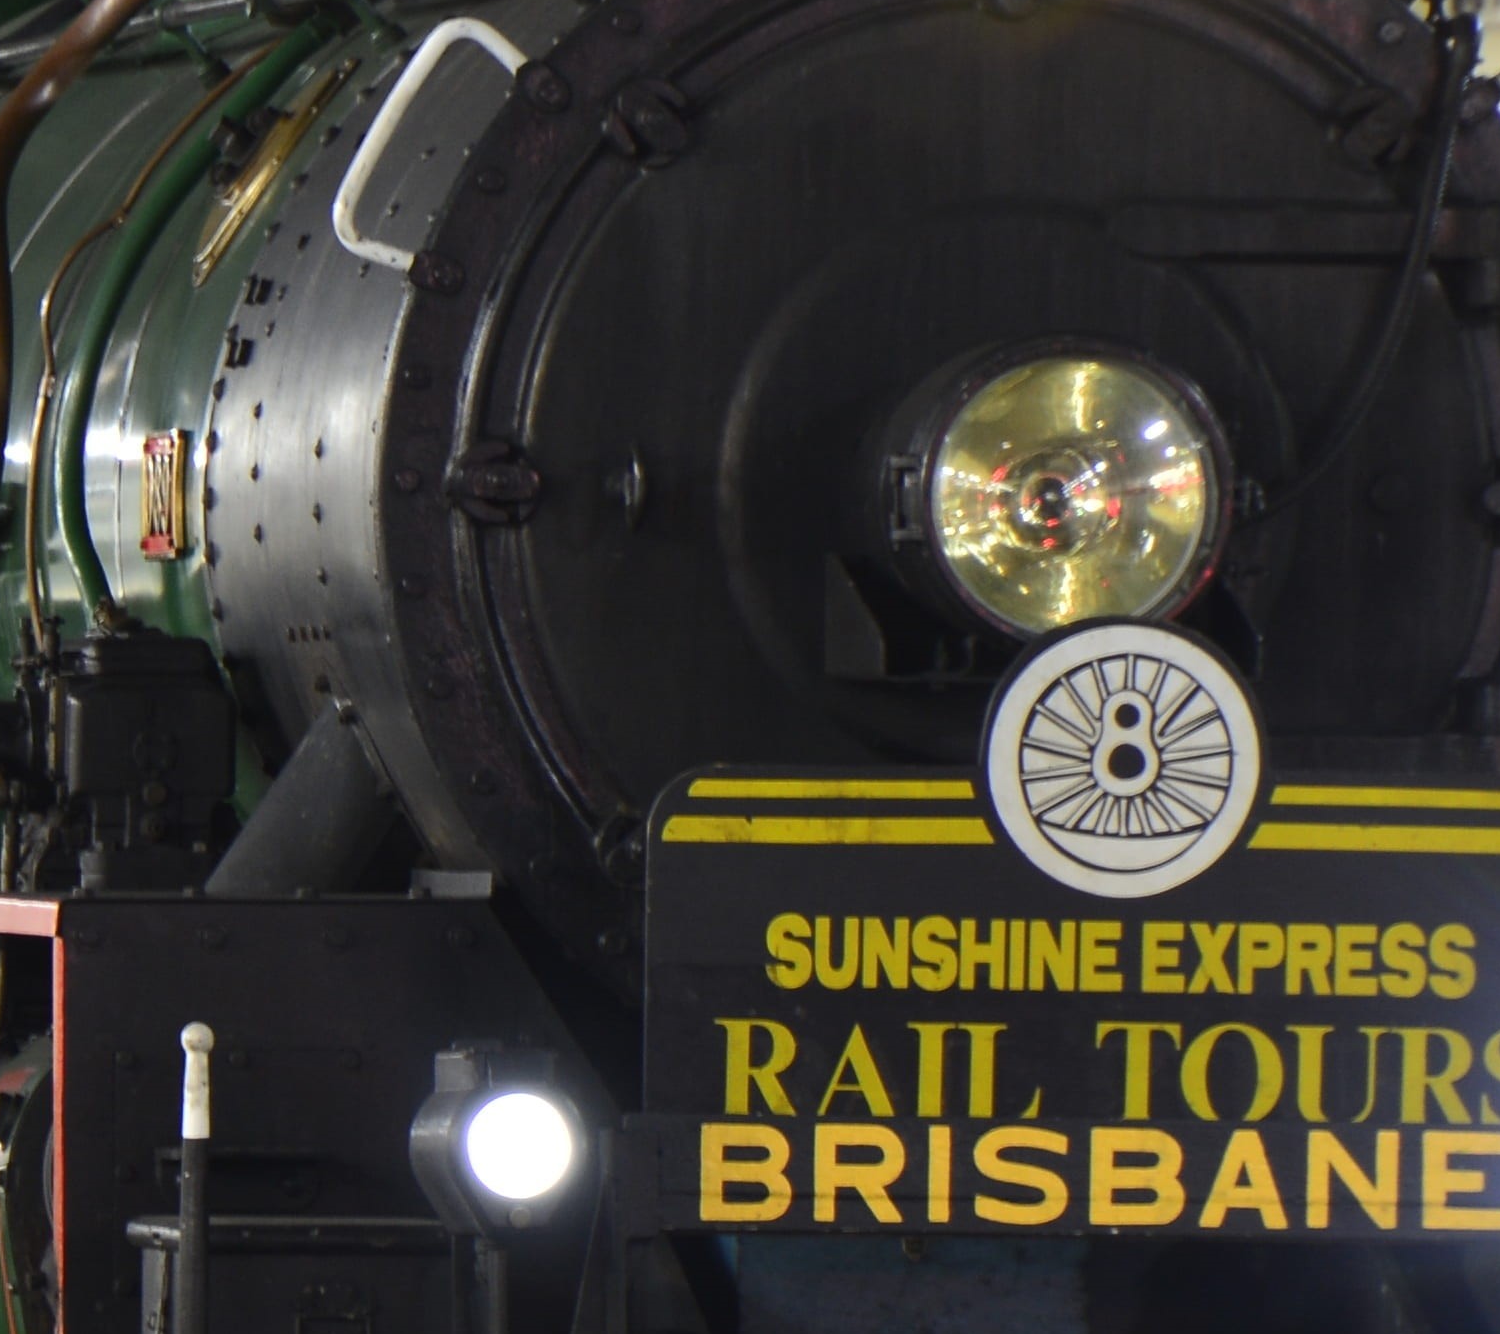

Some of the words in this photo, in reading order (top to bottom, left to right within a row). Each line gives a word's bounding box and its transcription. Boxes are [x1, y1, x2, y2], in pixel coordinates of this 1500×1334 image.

[764, 912, 1124, 993] SUNSHINE
[1140, 920, 1477, 999] EXPRESS
[714, 1018, 1041, 1119] RAIL
